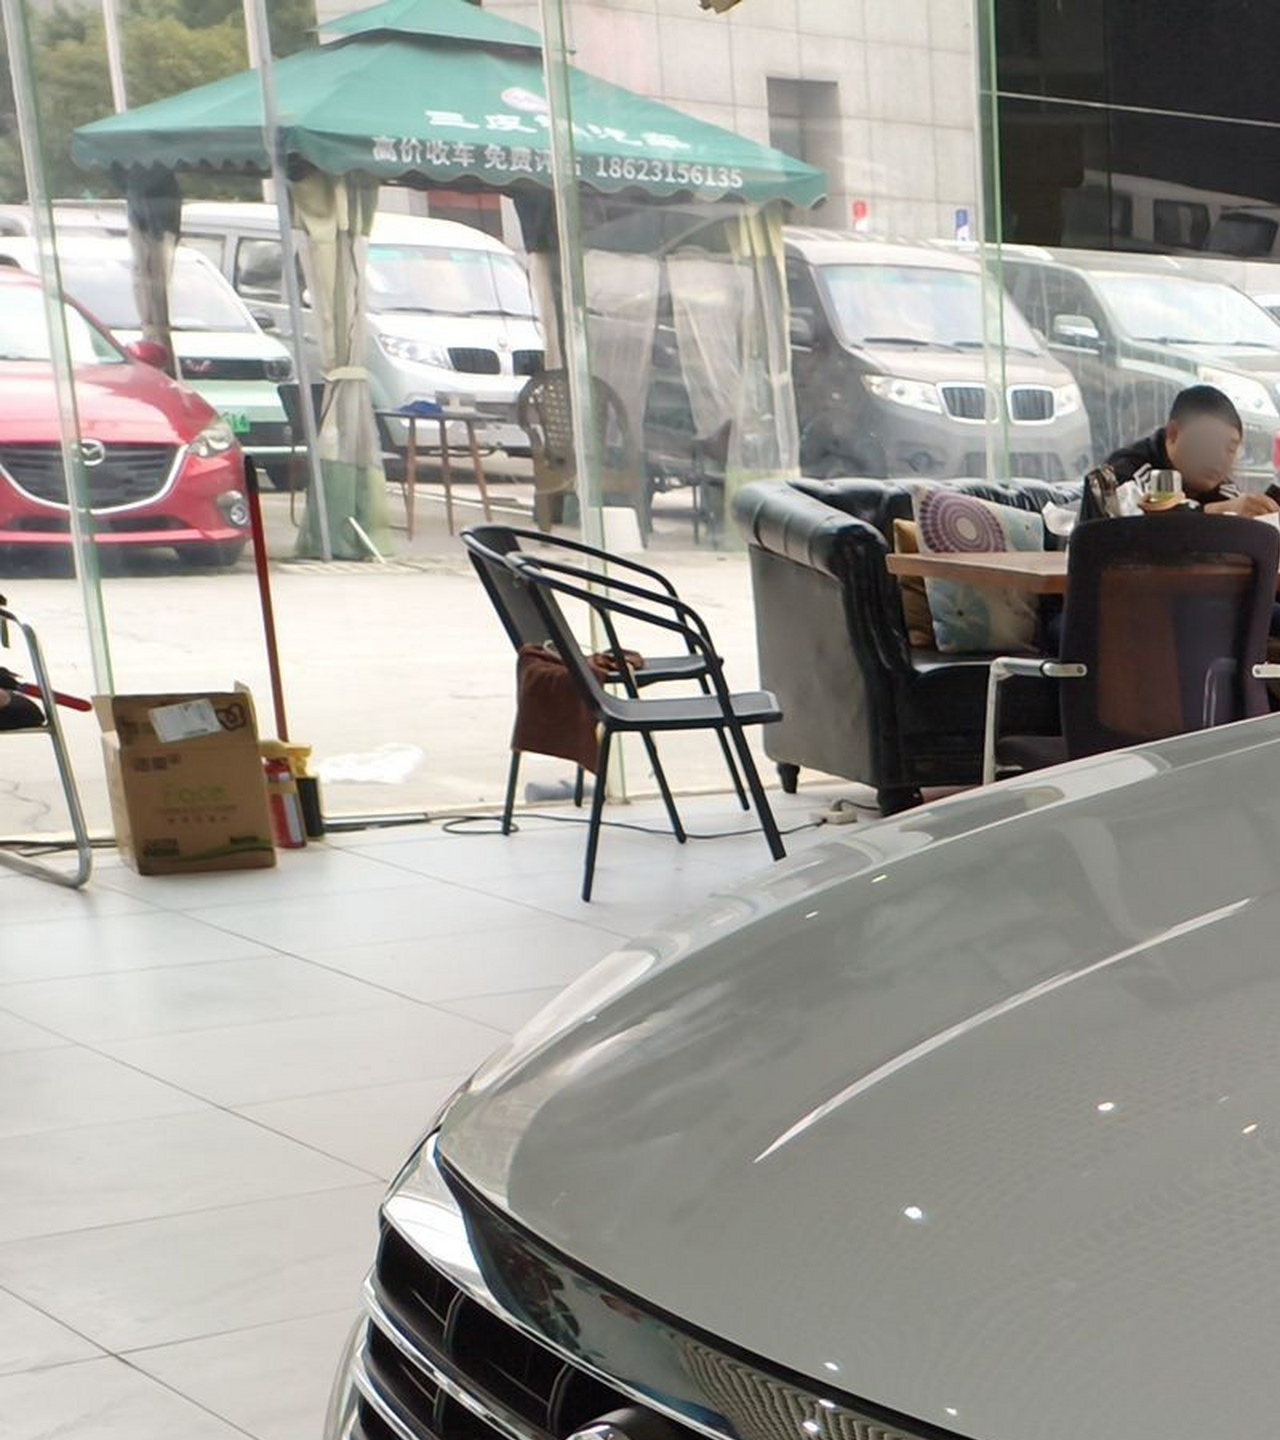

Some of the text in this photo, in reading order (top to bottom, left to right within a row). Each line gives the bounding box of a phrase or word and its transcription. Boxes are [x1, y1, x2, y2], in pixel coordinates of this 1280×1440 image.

[373, 136, 475, 168] 高价收车
[596, 155, 743, 189] 18623156135
